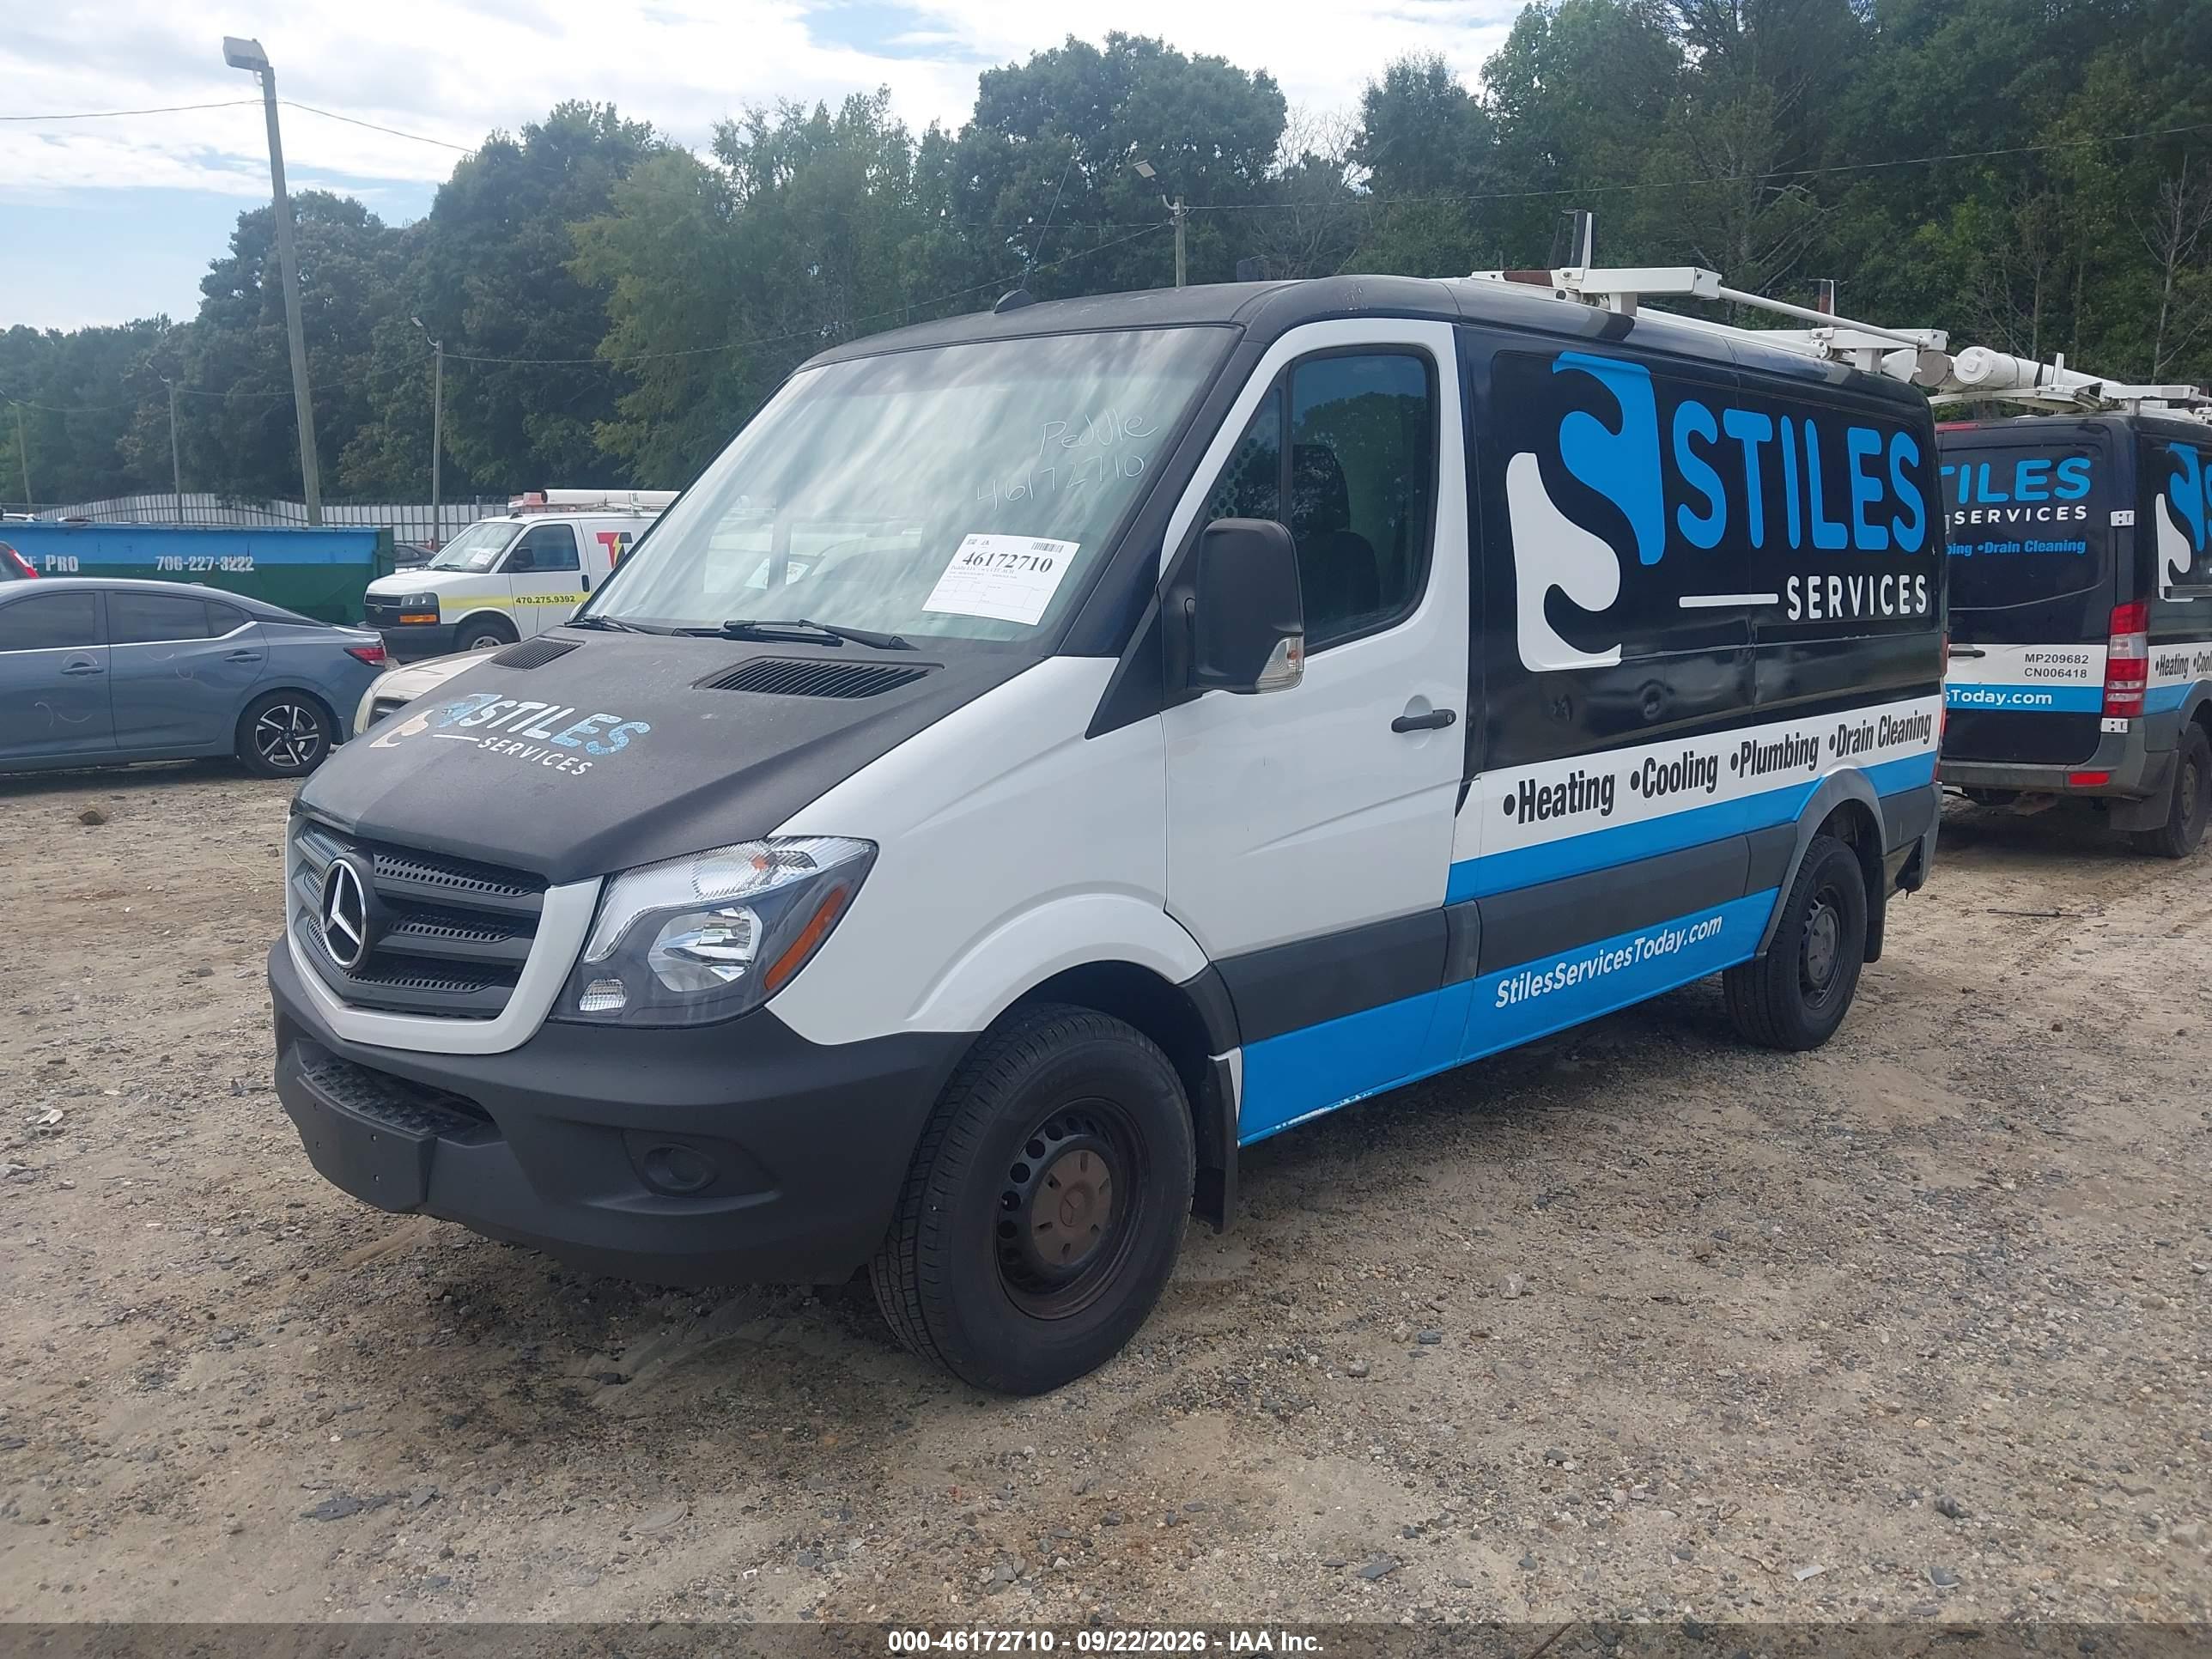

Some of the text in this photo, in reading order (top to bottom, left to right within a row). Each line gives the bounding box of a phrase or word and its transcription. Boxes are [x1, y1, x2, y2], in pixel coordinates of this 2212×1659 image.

[976, 455, 1145, 510] 46172710
[1673, 400, 1926, 553] STILES
[1942, 458, 2091, 504] ILES
[1954, 505, 2087, 525] SERVICES
[2024, 539, 2087, 554] Cleaning
[45, 555, 79, 572] PRO
[155, 556, 255, 572] 706-227-3222
[962, 551, 1054, 573] 46172710
[515, 595, 576, 604] 470.275.9392
[1787, 574, 1928, 621] SERVICES
[2024, 653, 2089, 664] MP209682
[2024, 668, 2087, 678] CN006418
[459, 700, 651, 756] STILES
[1877, 709, 1932, 748] Cleaning
[477, 736, 593, 775] SERVICES
[1495, 915, 1723, 1009] StilesServicesToday.com
